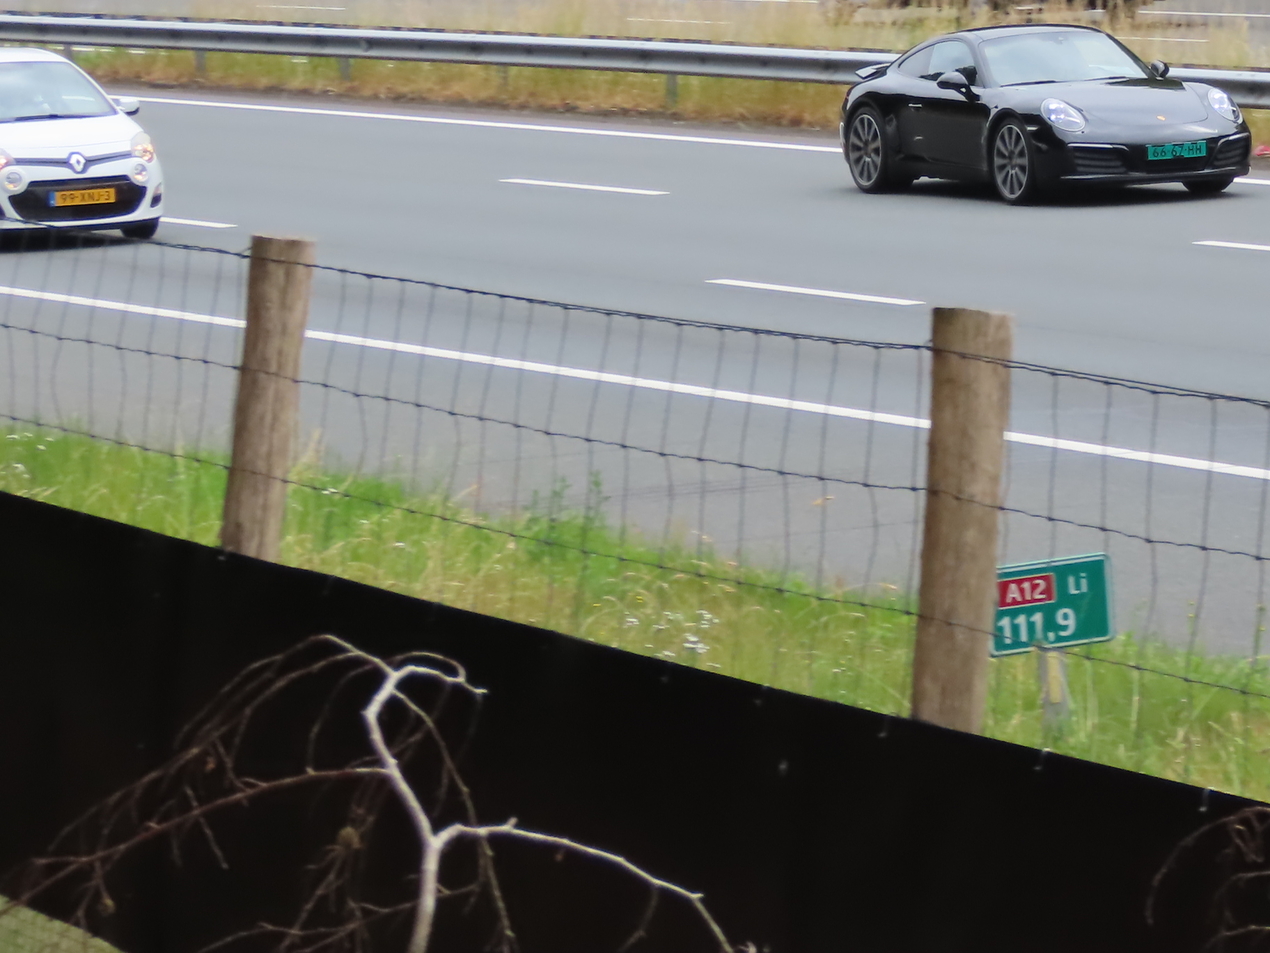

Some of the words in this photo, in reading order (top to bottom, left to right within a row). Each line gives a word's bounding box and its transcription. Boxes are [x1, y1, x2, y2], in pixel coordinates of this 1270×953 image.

[59, 190, 111, 204] 99-XNJ-3
[1006, 579, 1047, 603] A12
[1067, 573, 1089, 595] Li
